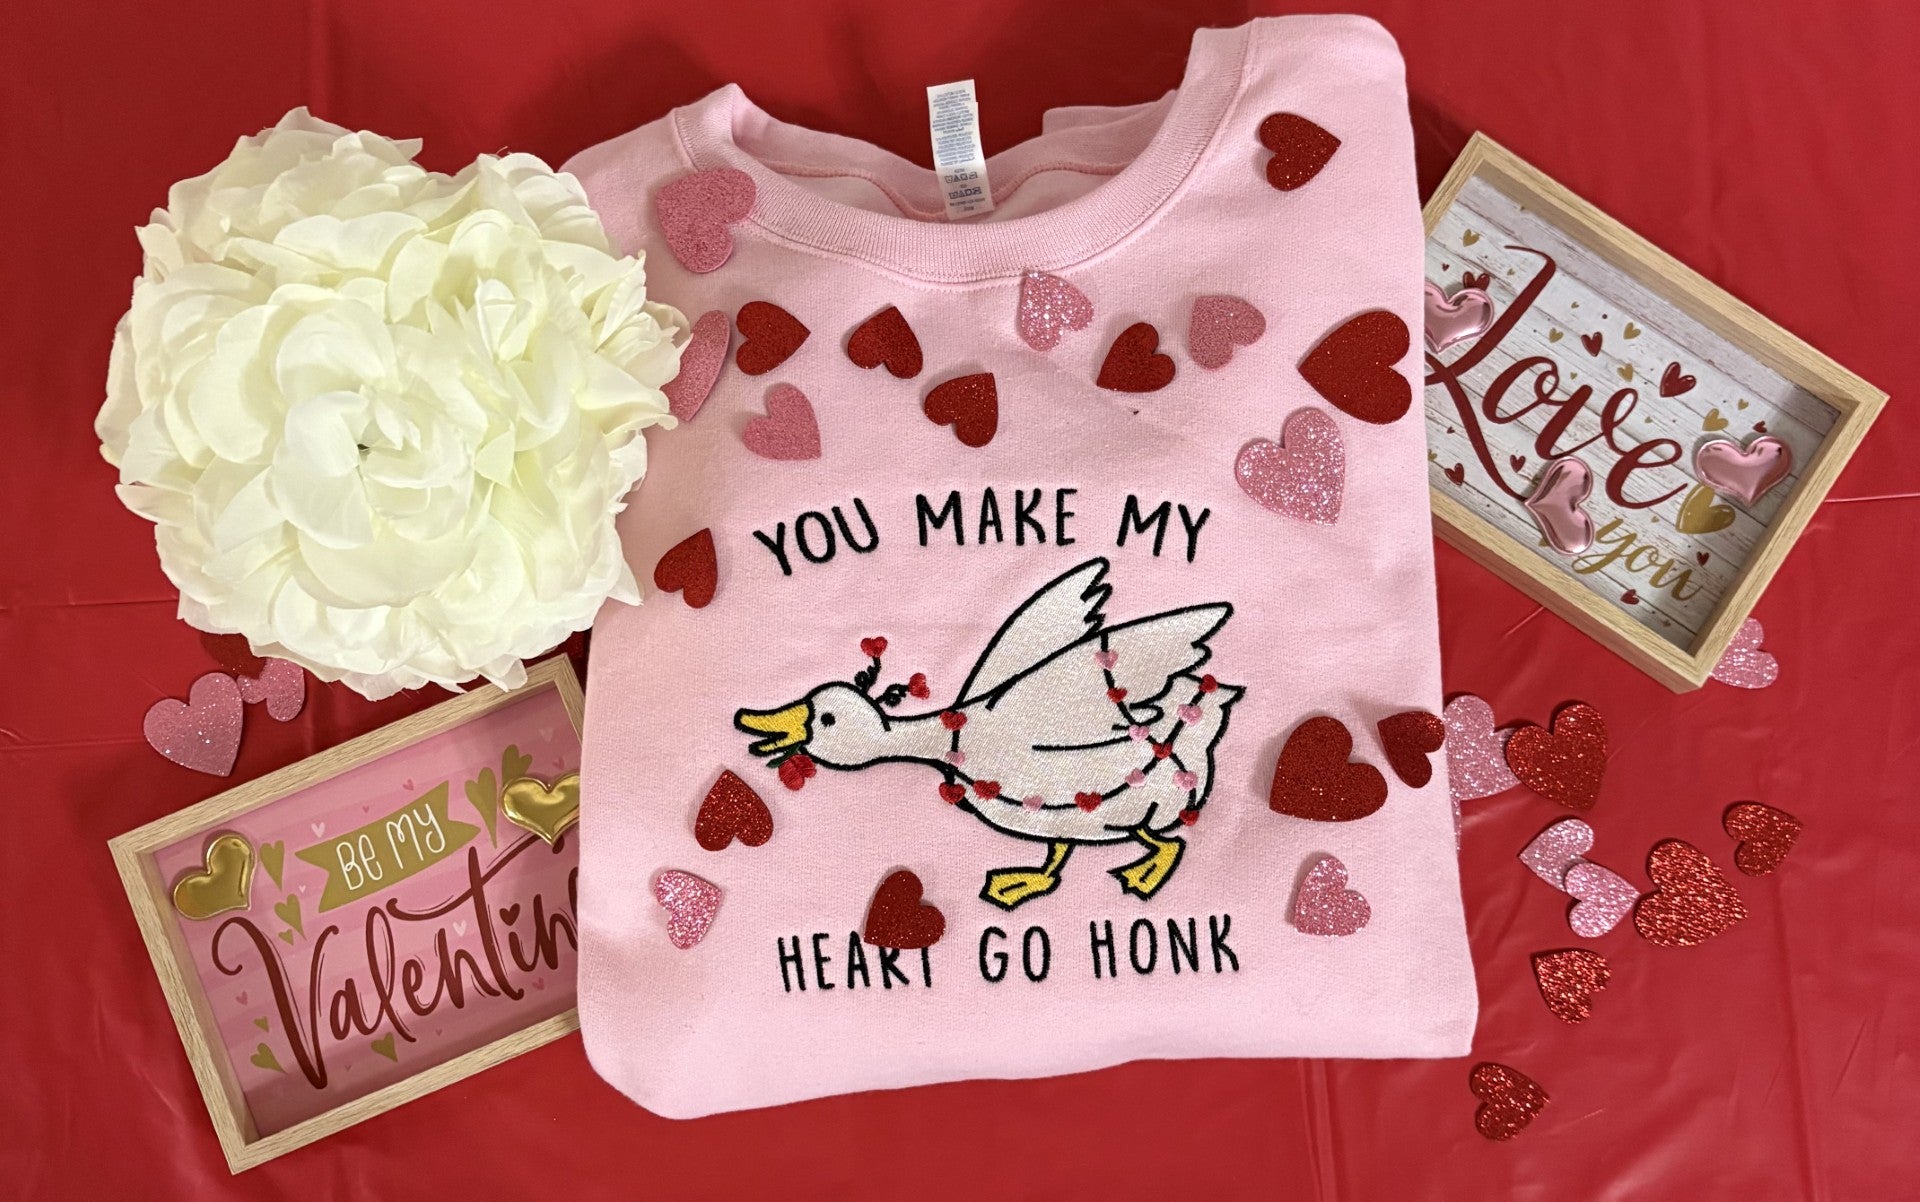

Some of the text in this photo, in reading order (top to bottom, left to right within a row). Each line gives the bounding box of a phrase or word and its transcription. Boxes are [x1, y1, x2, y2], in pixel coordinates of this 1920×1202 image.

[1425, 245, 1689, 510] Love
[754, 488, 1210, 575] YOU MAKE MY
[1571, 517, 1703, 601] you
[211, 836, 579, 1090] Valentin
[980, 927, 1050, 982] GO
[1090, 915, 1239, 978] HONK
